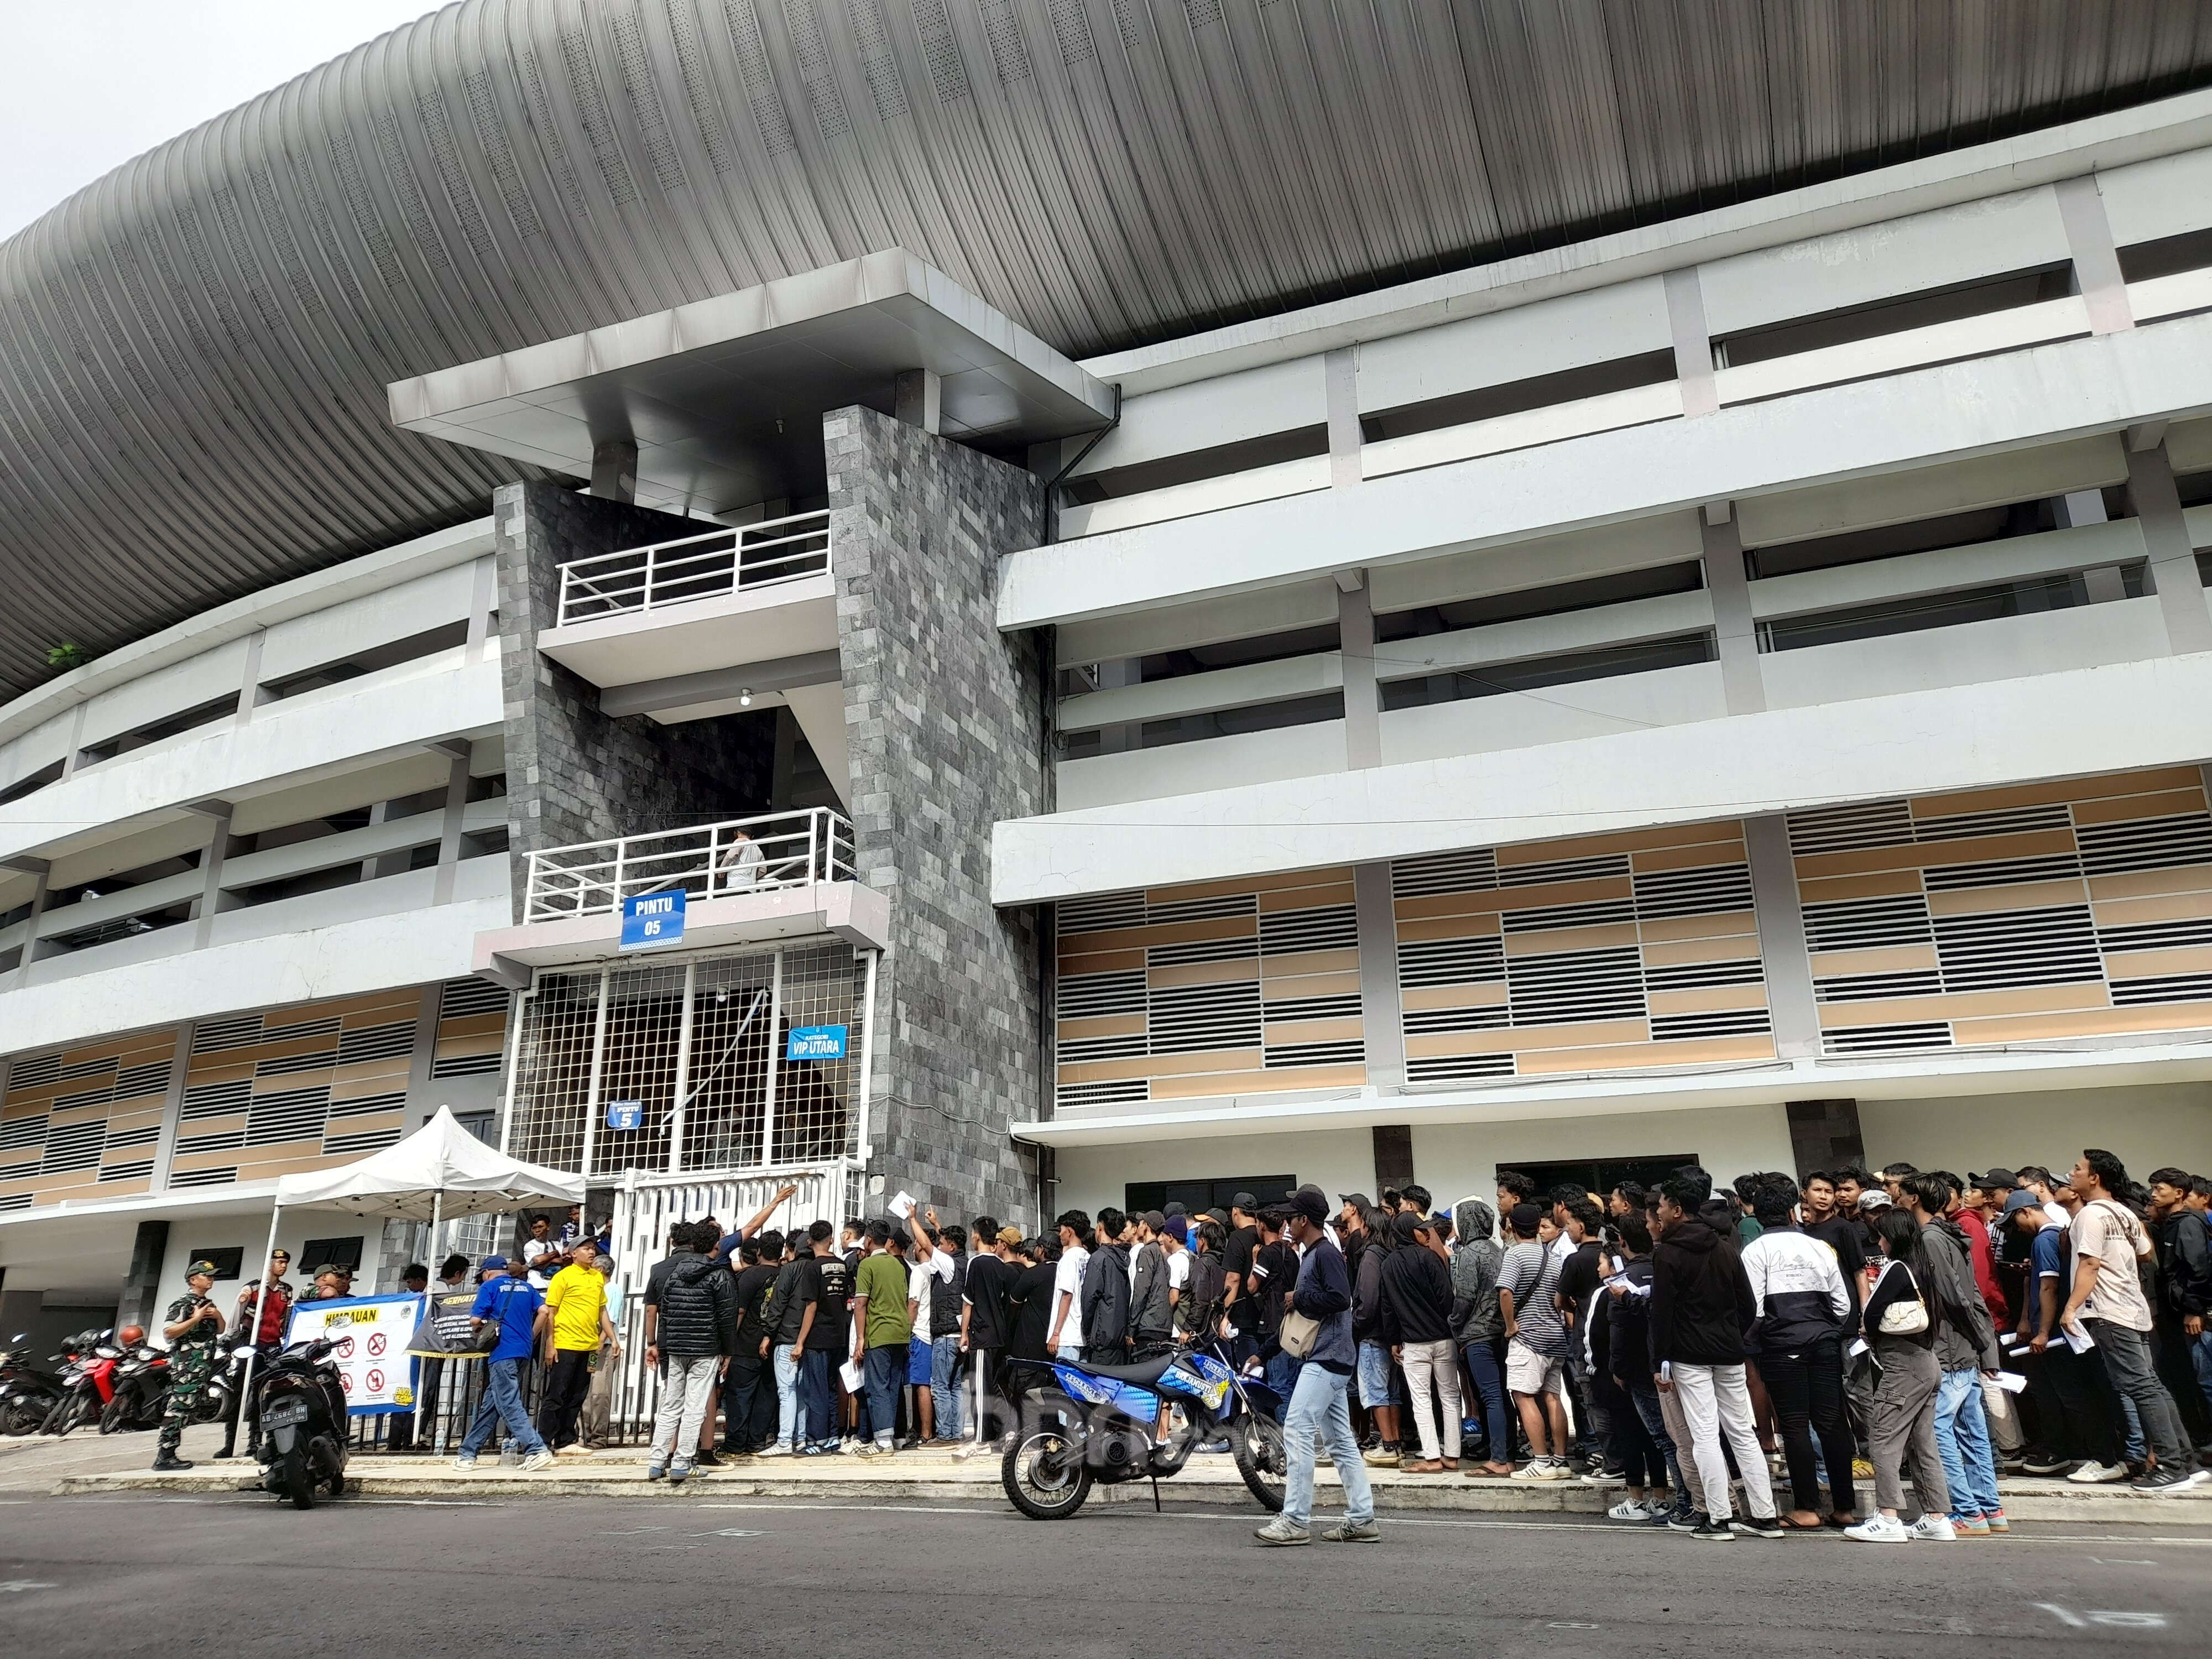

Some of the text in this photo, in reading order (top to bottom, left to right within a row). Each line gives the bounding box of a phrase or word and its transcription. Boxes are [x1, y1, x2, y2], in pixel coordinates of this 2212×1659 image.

[635, 896, 672, 916] PINTU
[644, 920, 661, 936] 05
[793, 1040, 839, 1055] VIP UTARA
[620, 1113, 633, 1127] 5
[261, 1415, 271, 1423] AB
